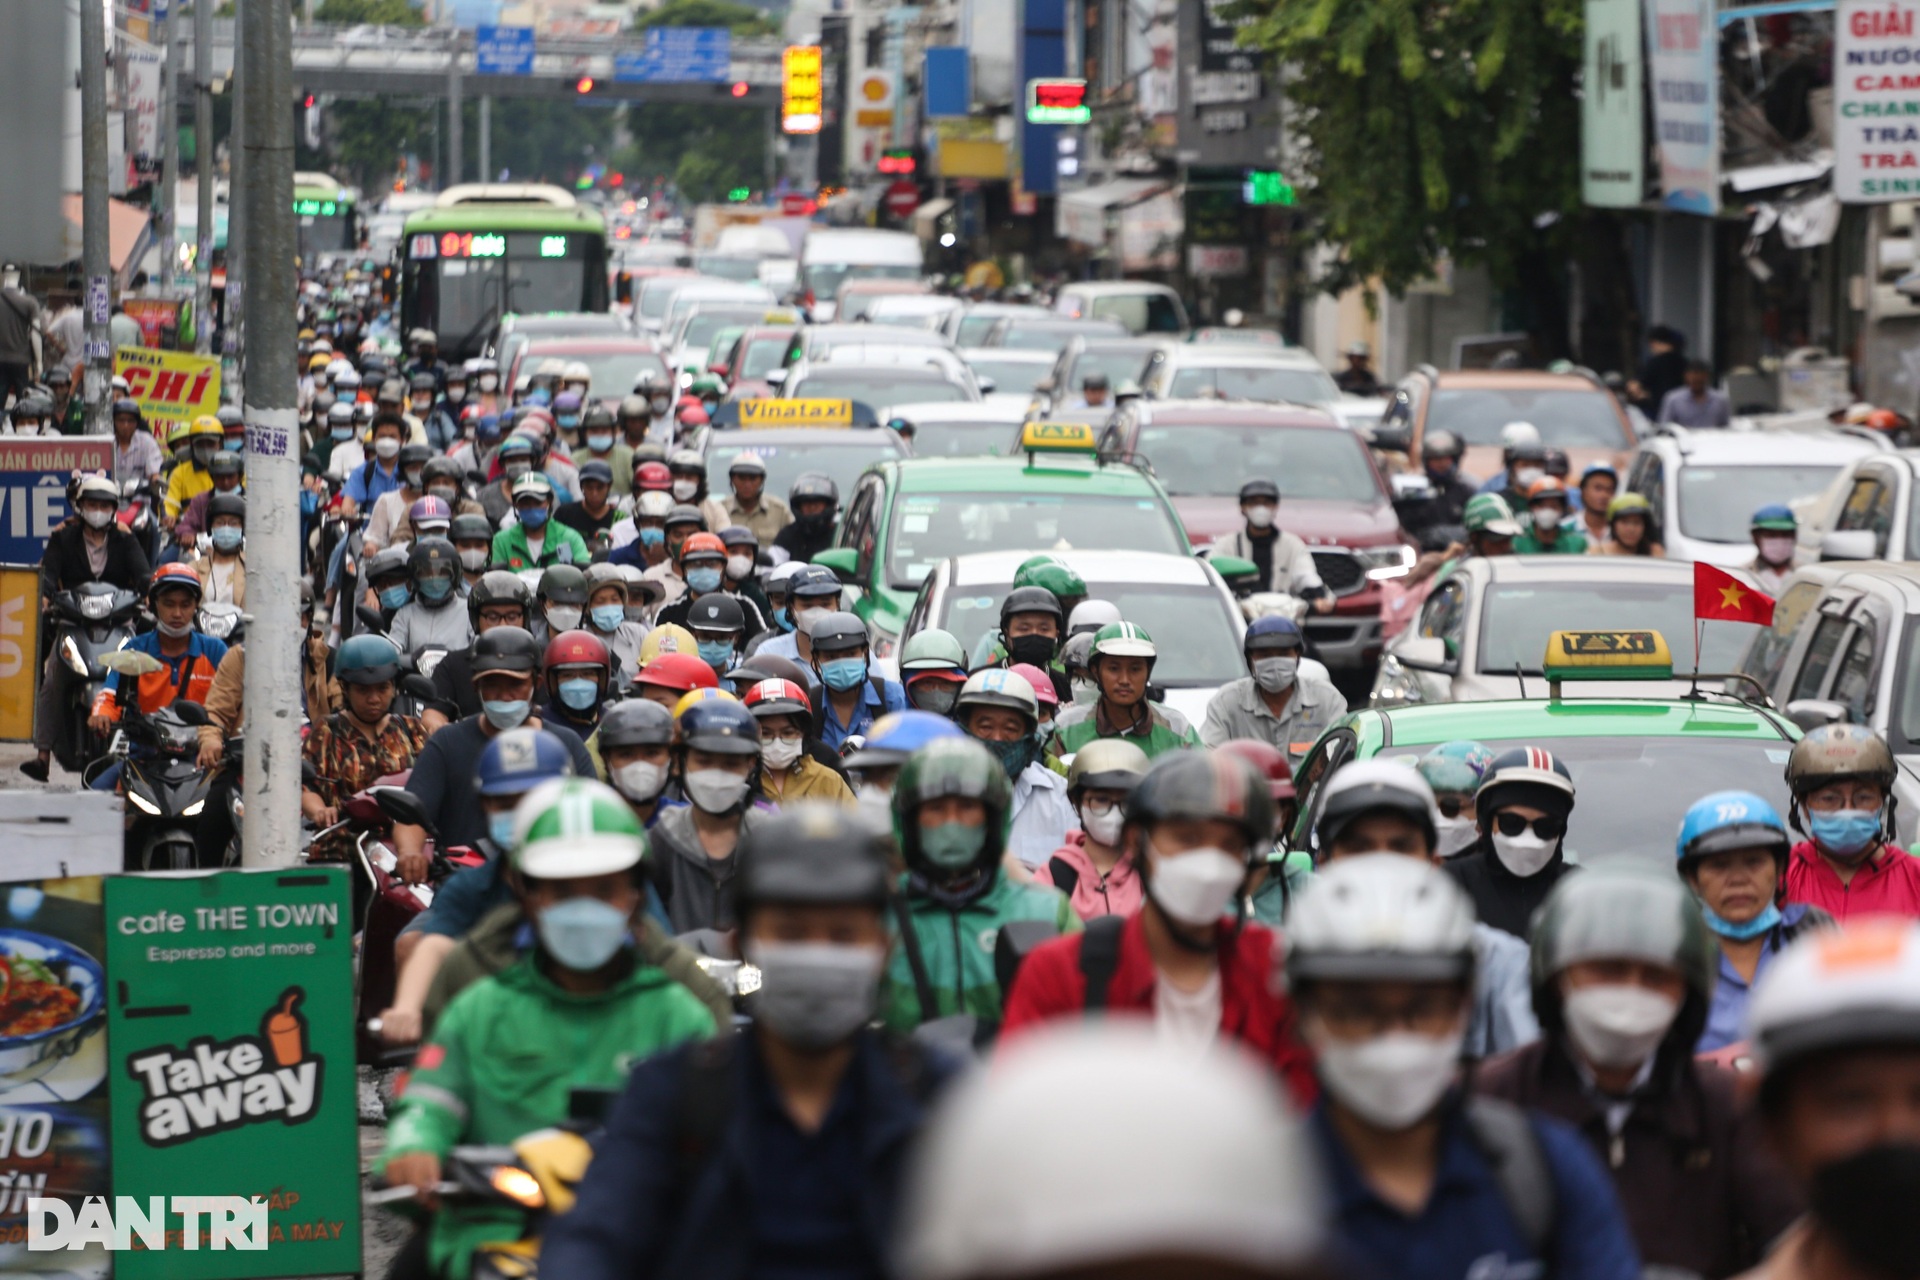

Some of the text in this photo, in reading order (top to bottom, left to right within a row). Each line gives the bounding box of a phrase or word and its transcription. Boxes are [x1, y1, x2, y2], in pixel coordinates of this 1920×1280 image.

[1861, 178, 1920, 195] SIN
[745, 403, 846, 417] Vinataxi
[118, 903, 338, 935] cafe THE TOWN
[147, 942, 316, 963] Espresso and more
[133, 1043, 263, 1097] Take
[145, 1062, 317, 1140] away
[291, 1218, 344, 1242] MÁY
